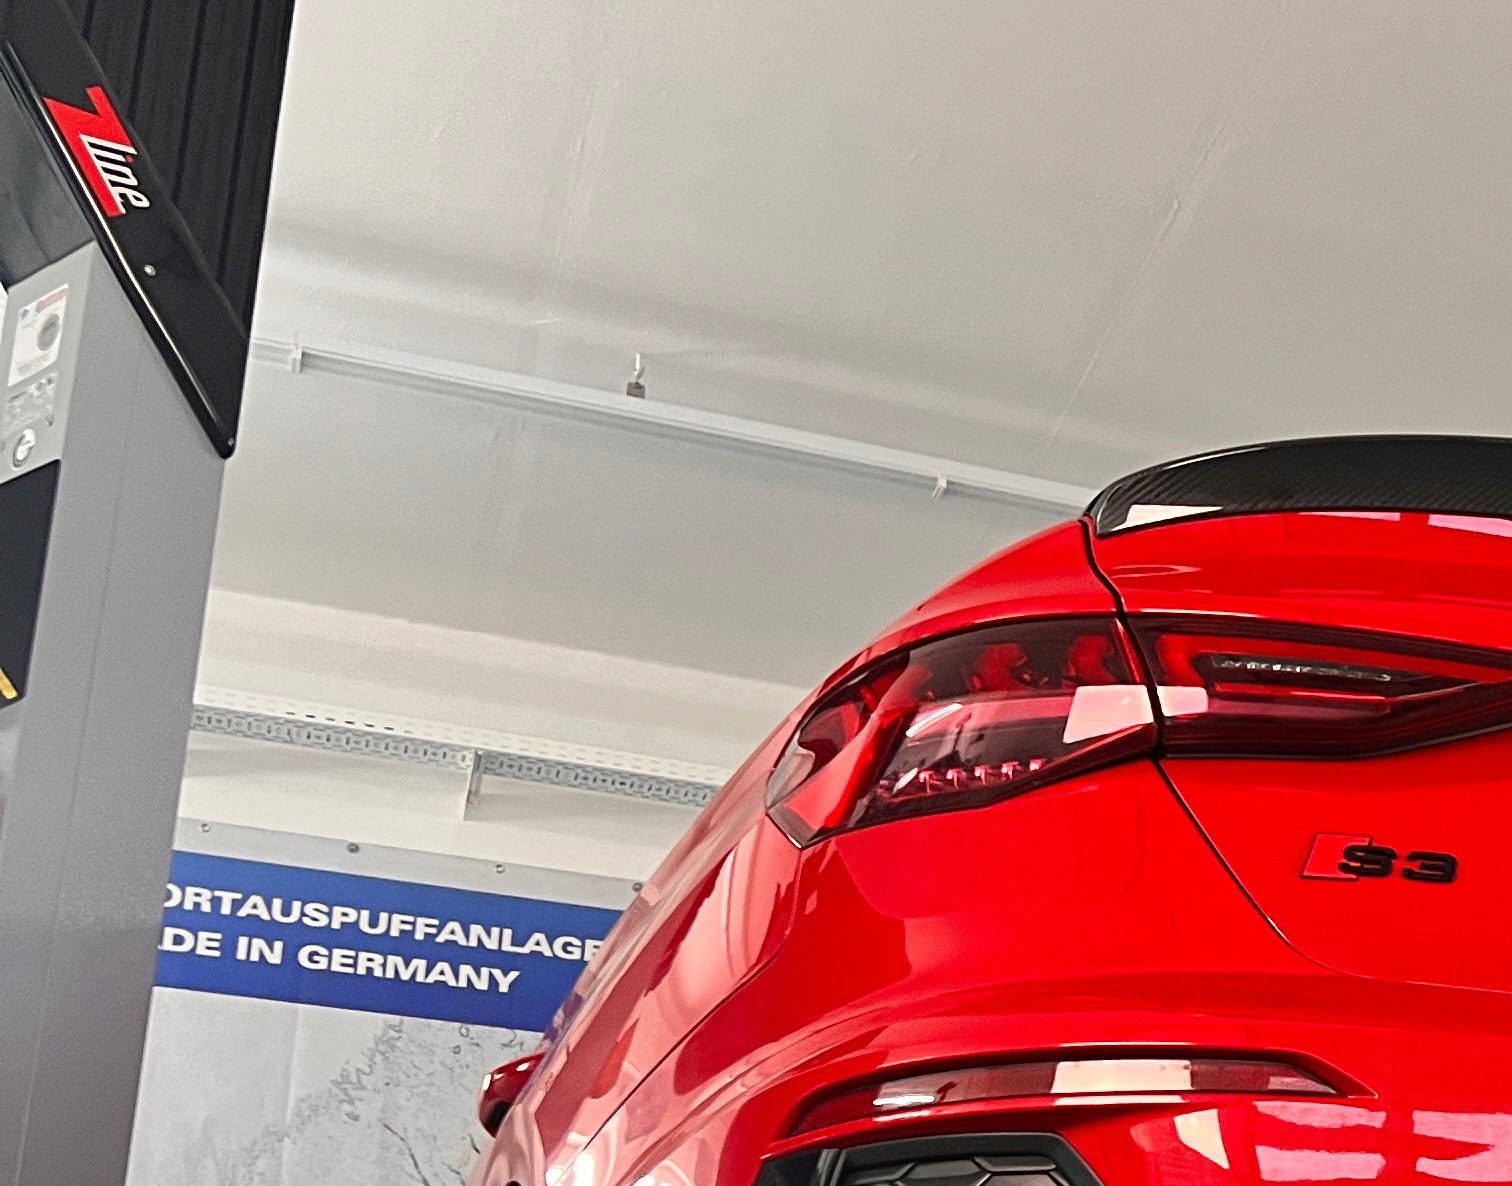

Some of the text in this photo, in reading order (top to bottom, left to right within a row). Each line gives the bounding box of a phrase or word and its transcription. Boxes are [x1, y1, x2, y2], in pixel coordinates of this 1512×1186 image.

[1337, 843, 1458, 883] S3
[158, 926, 521, 993] DE IN GERMANY
